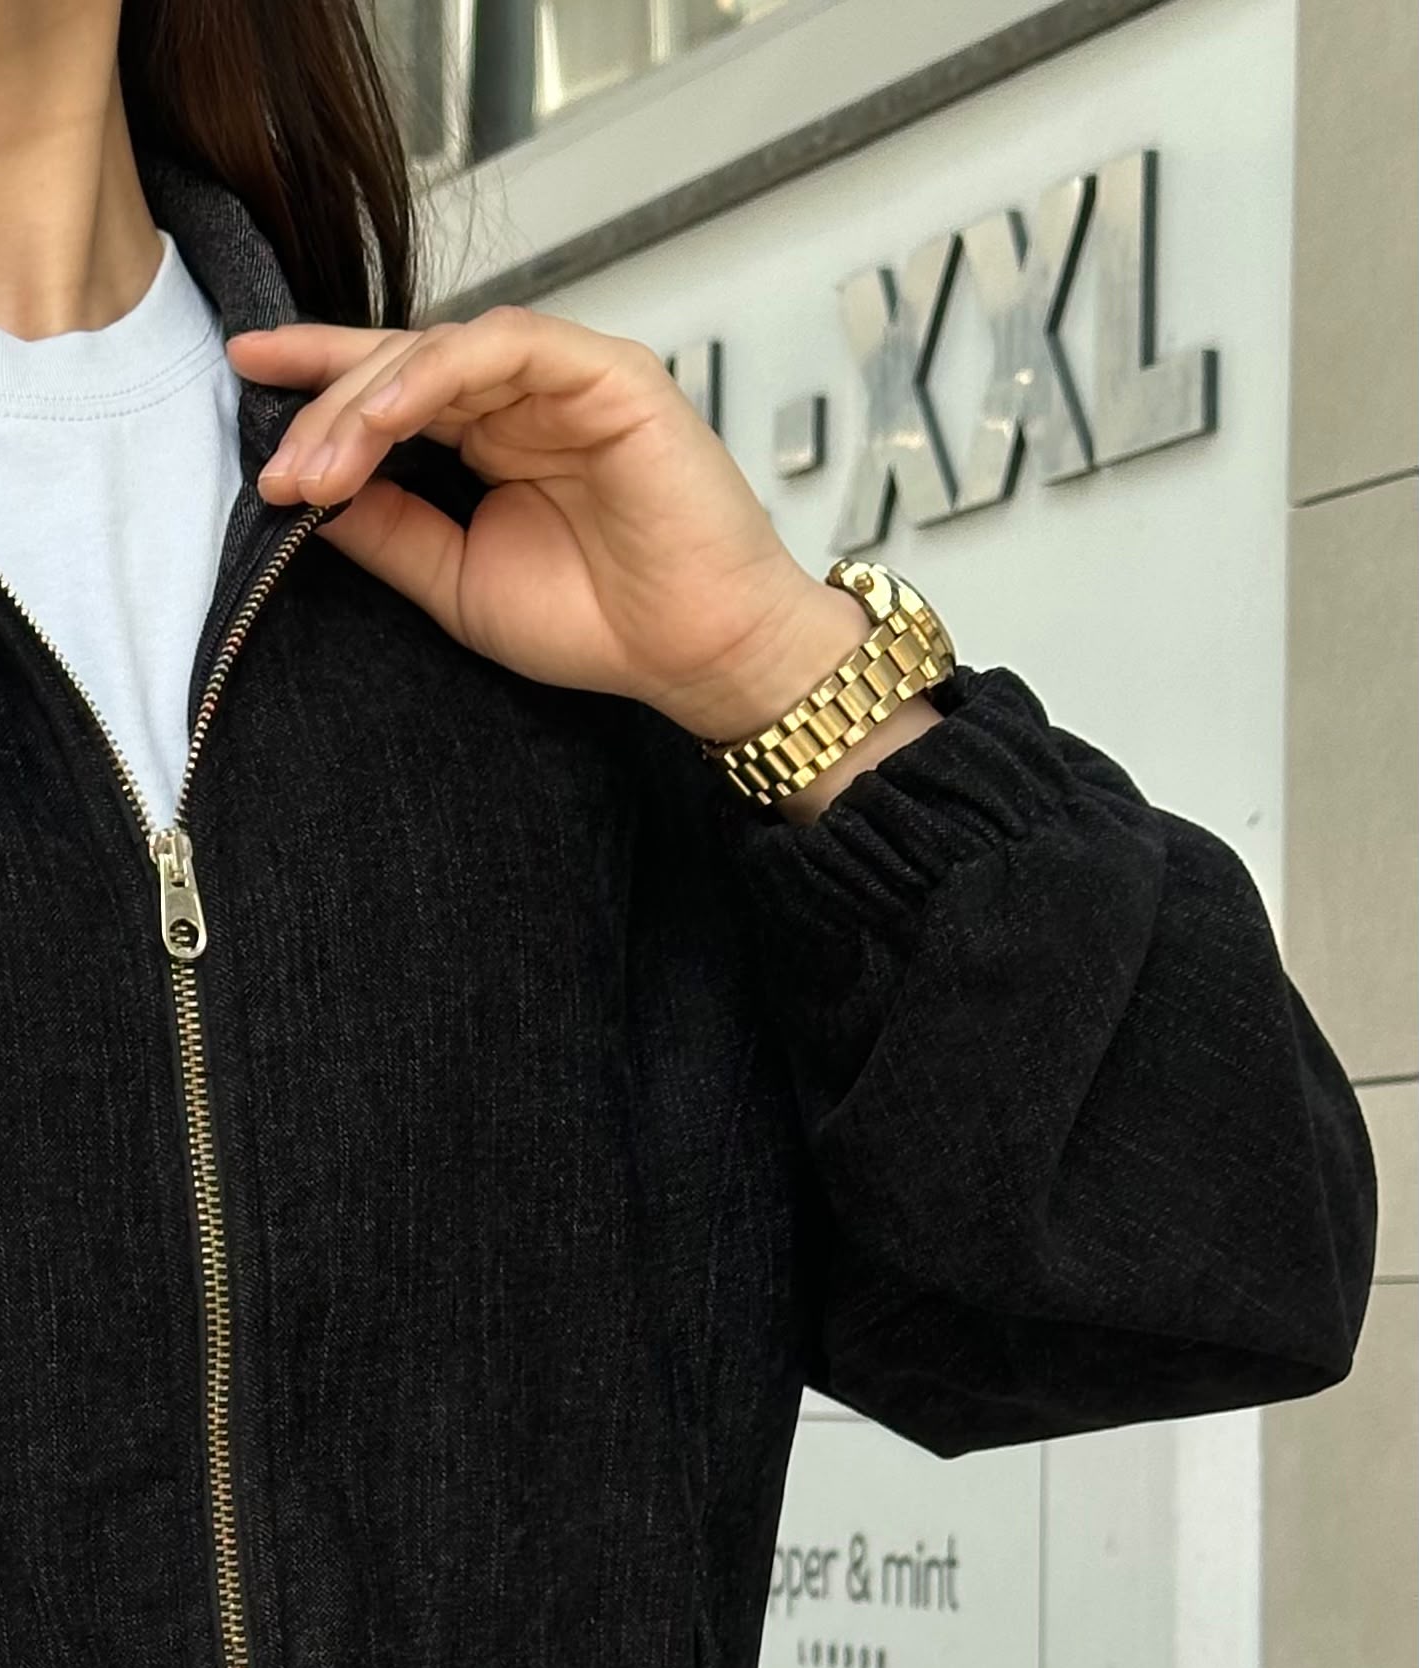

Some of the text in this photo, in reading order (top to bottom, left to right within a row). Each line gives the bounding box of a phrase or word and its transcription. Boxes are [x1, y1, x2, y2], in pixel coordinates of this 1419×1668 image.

[664, 149, 1219, 556] -XXL
[769, 1531, 961, 1620] pper & mint
